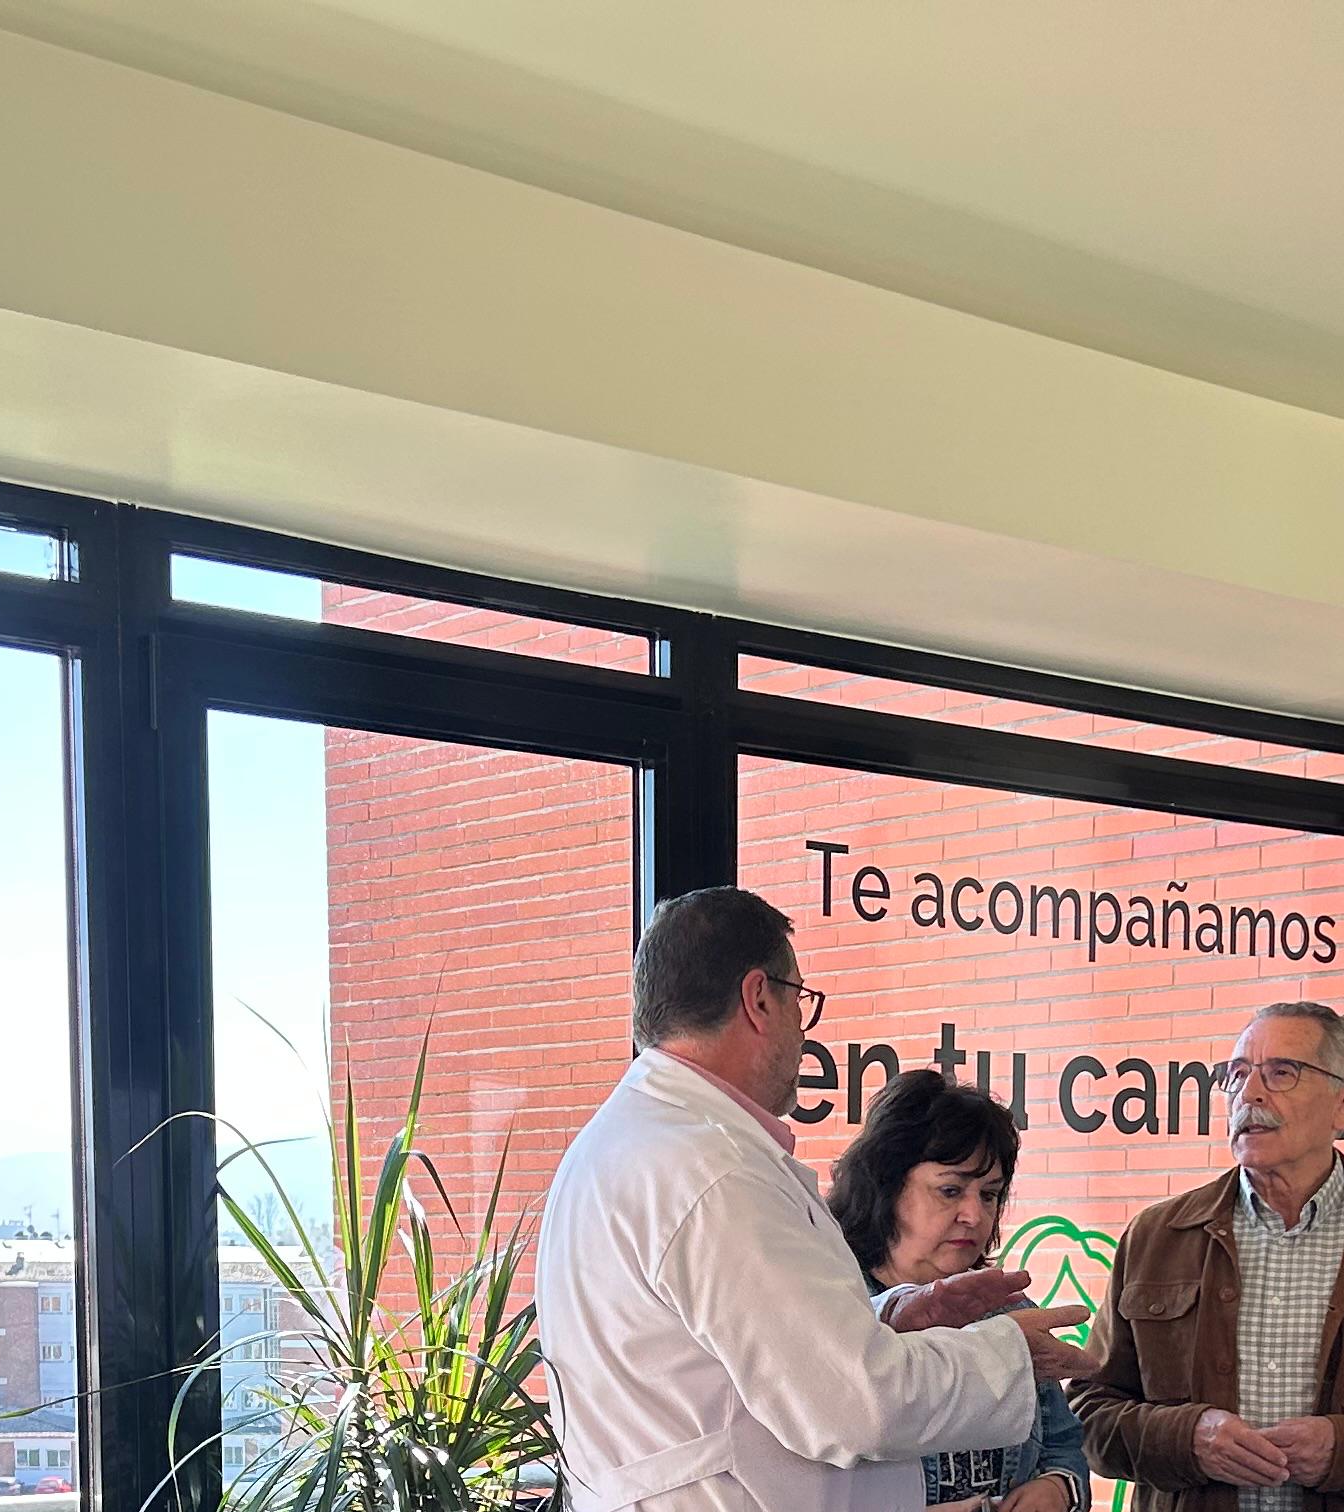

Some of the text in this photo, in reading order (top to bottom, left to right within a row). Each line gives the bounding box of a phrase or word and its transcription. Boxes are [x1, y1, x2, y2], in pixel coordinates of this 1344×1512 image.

[805, 840, 1337, 964] Te acompañamos
[789, 1038, 900, 1125] en
